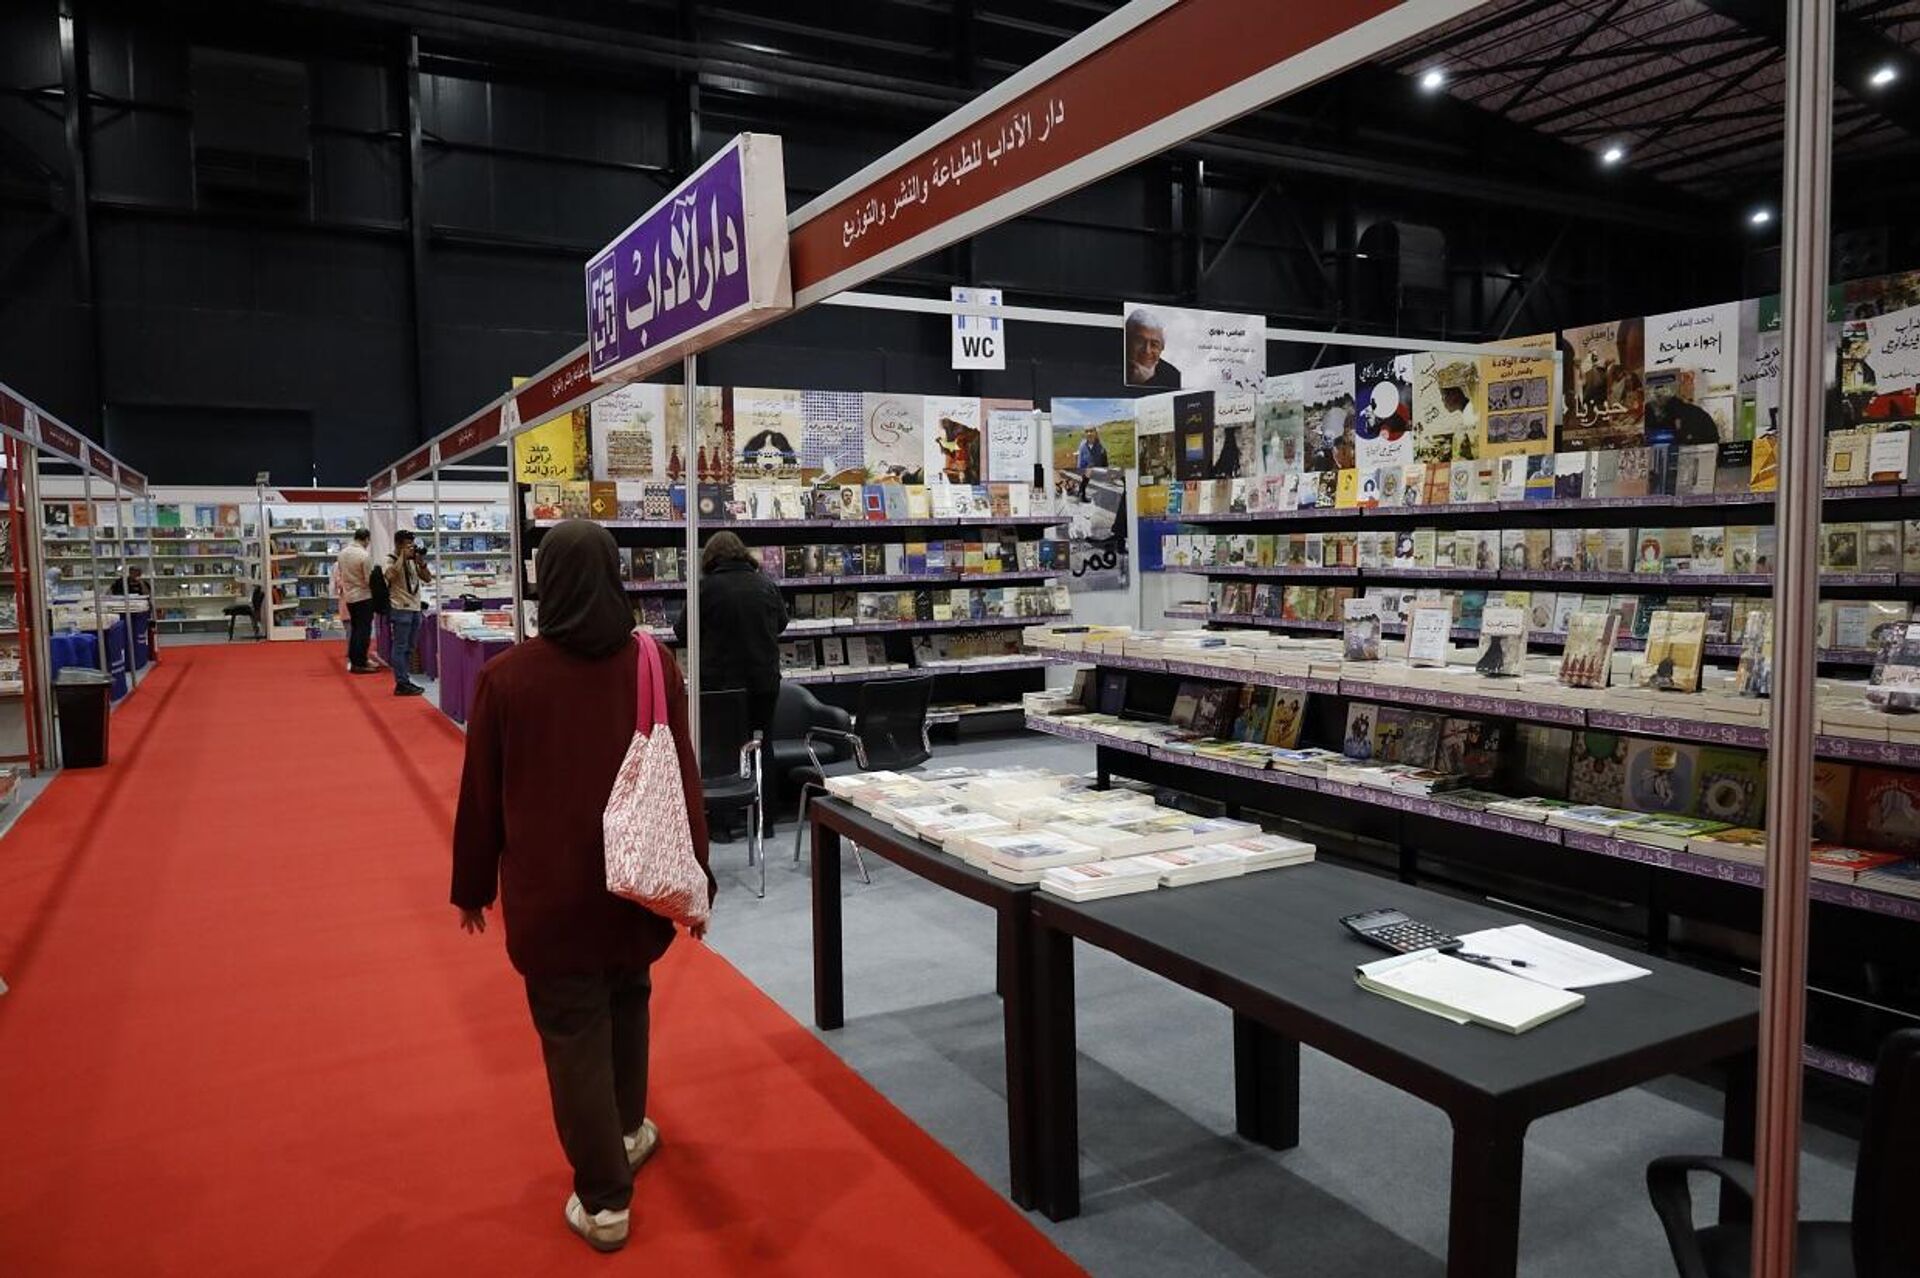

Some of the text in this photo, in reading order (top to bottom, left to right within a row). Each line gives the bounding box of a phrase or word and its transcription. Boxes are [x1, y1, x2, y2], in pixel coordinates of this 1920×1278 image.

[1039, 99, 1064, 141] دار
[932, 139, 982, 186] للطباعة
[890, 175, 929, 220] والنشر
[842, 198, 886, 248] والتوزيع
[696, 192, 739, 311] دار
[962, 336, 995, 358] WC
